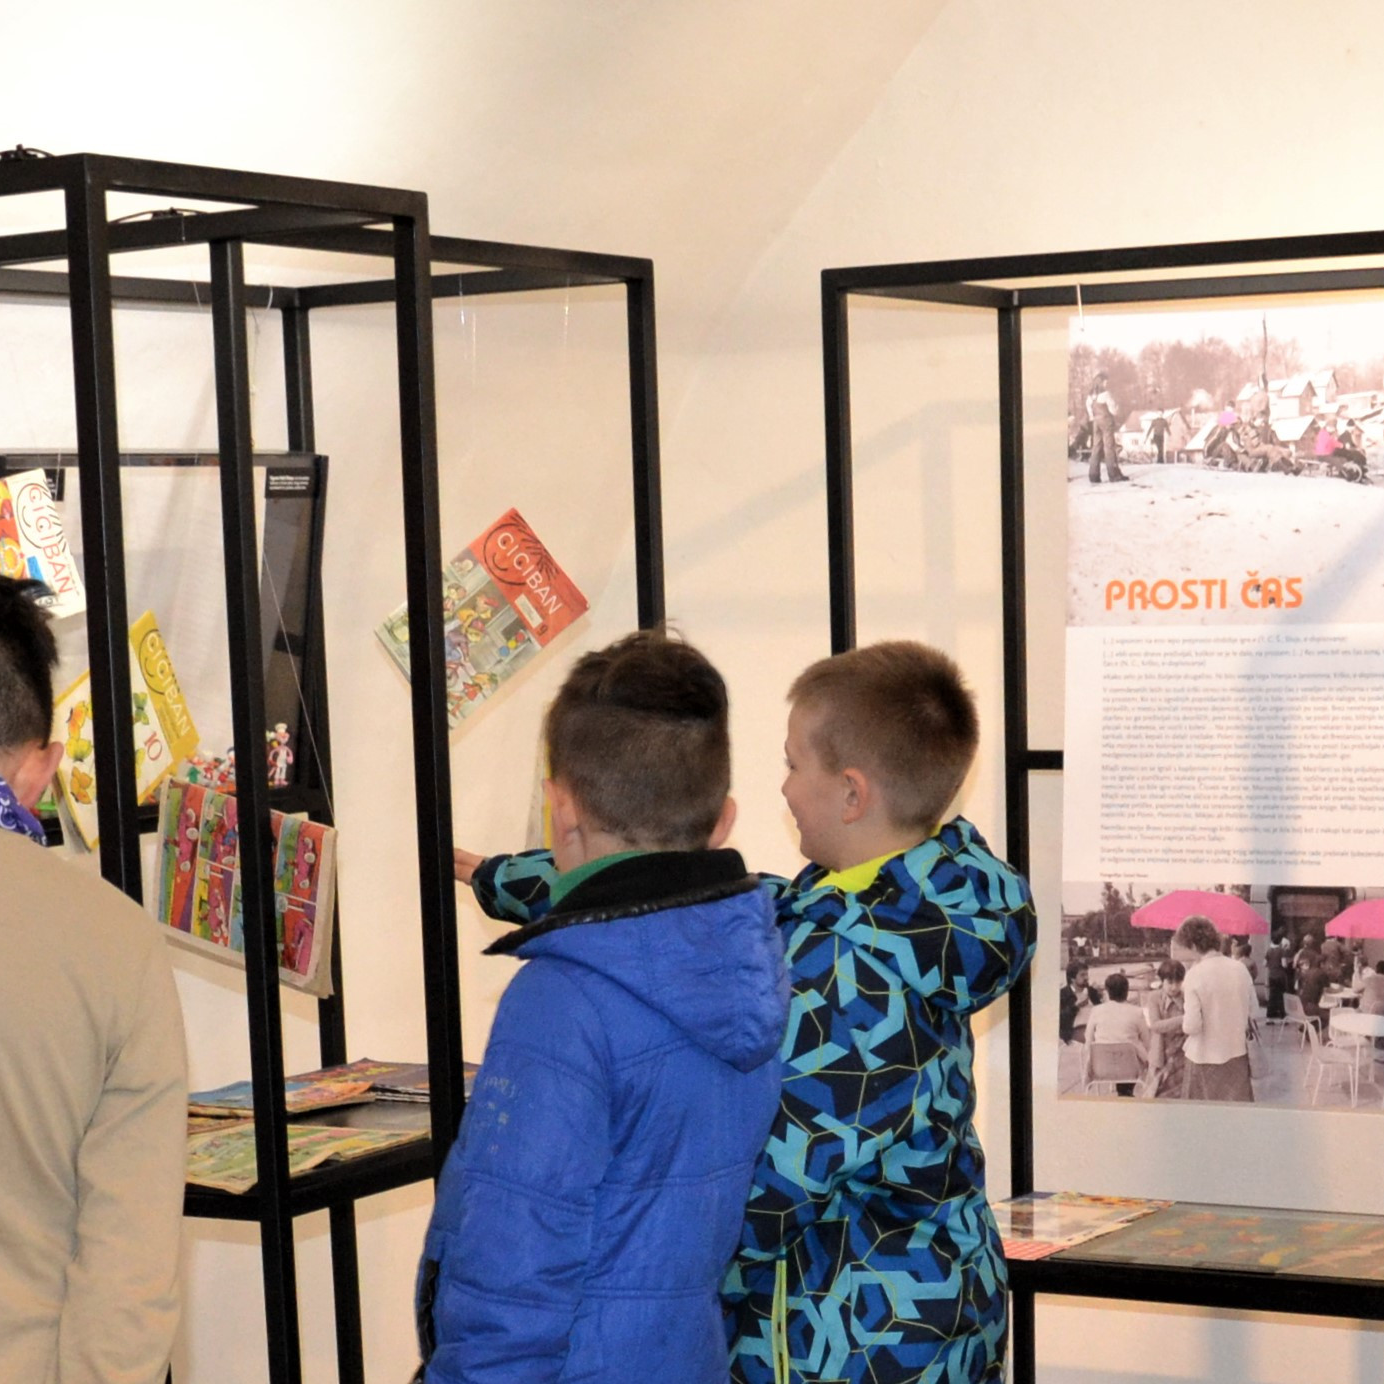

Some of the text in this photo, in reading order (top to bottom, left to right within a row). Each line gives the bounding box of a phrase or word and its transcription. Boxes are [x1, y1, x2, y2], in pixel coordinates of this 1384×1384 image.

[28, 486, 74, 594] CICIBAN
[497, 531, 563, 615] CICIBAN
[1104, 570, 1304, 611] PROSTI ČAS
[146, 632, 191, 736] CICIBAN
[144, 731, 163, 761] 10
